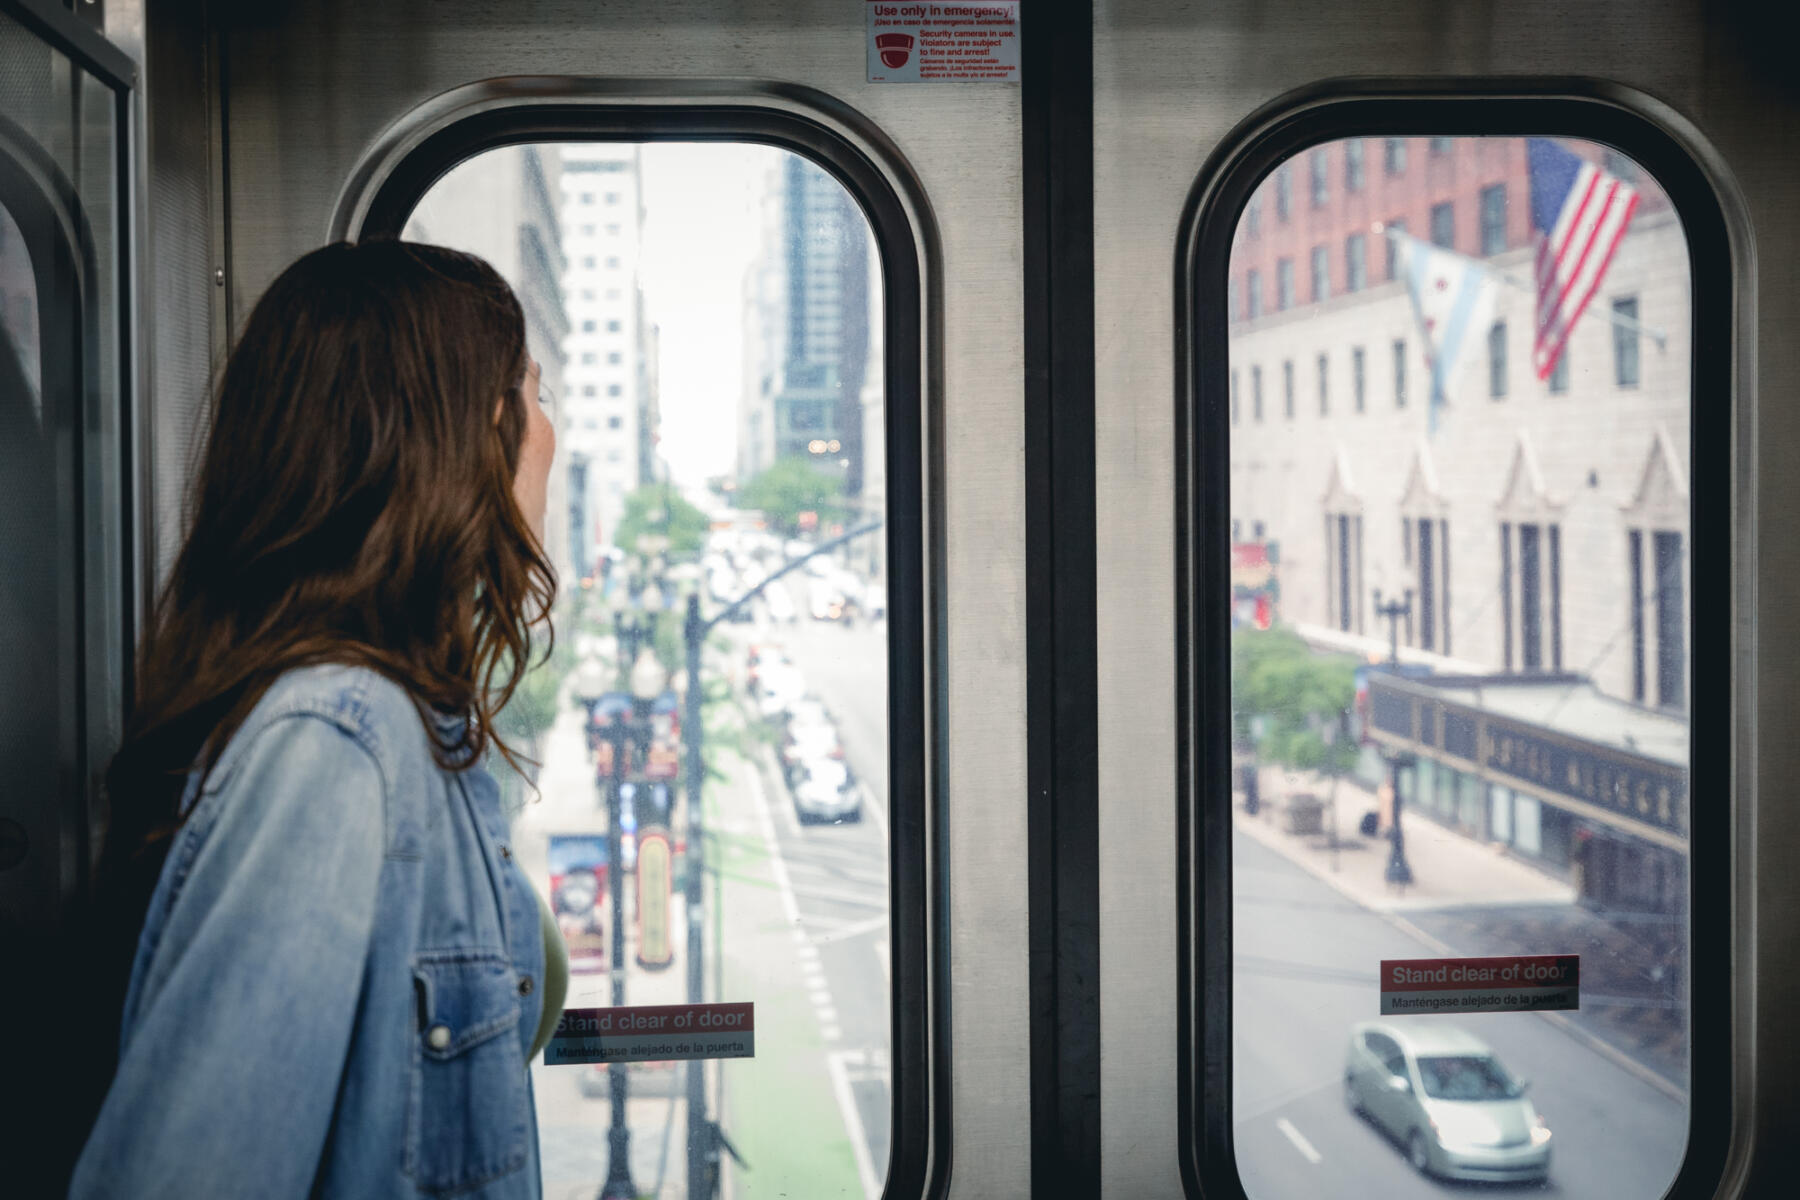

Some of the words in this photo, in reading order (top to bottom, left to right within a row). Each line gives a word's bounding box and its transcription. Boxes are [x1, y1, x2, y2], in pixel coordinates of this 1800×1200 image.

[874, 5, 898, 16] Use
[901, 5, 926, 18] only
[930, 5, 941, 16] in
[944, 5, 1014, 18] emergency!
[920, 30, 952, 38] Security
[972, 39, 1002, 48] subject
[1392, 966, 1447, 984] Stand
[1451, 965, 1497, 982] clear
[1501, 964, 1520, 980] of
[1524, 963, 1568, 980] door
[1392, 996, 1459, 1009] Manténgase
[1461, 995, 1501, 1008] alejado
[1503, 994, 1518, 1005] de
[1520, 993, 1530, 1005] la
[1532, 993, 1566, 1006] puerta
[556, 1013, 612, 1032] Stand
[618, 1012, 668, 1029] clear
[674, 1011, 693, 1027] of
[699, 1010, 745, 1027] door
[556, 1045, 627, 1060] Manténgase
[630, 1044, 673, 1057] alejado
[676, 1042, 690, 1054] de
[693, 1042, 704, 1053] la
[706, 1042, 744, 1055] puerta
